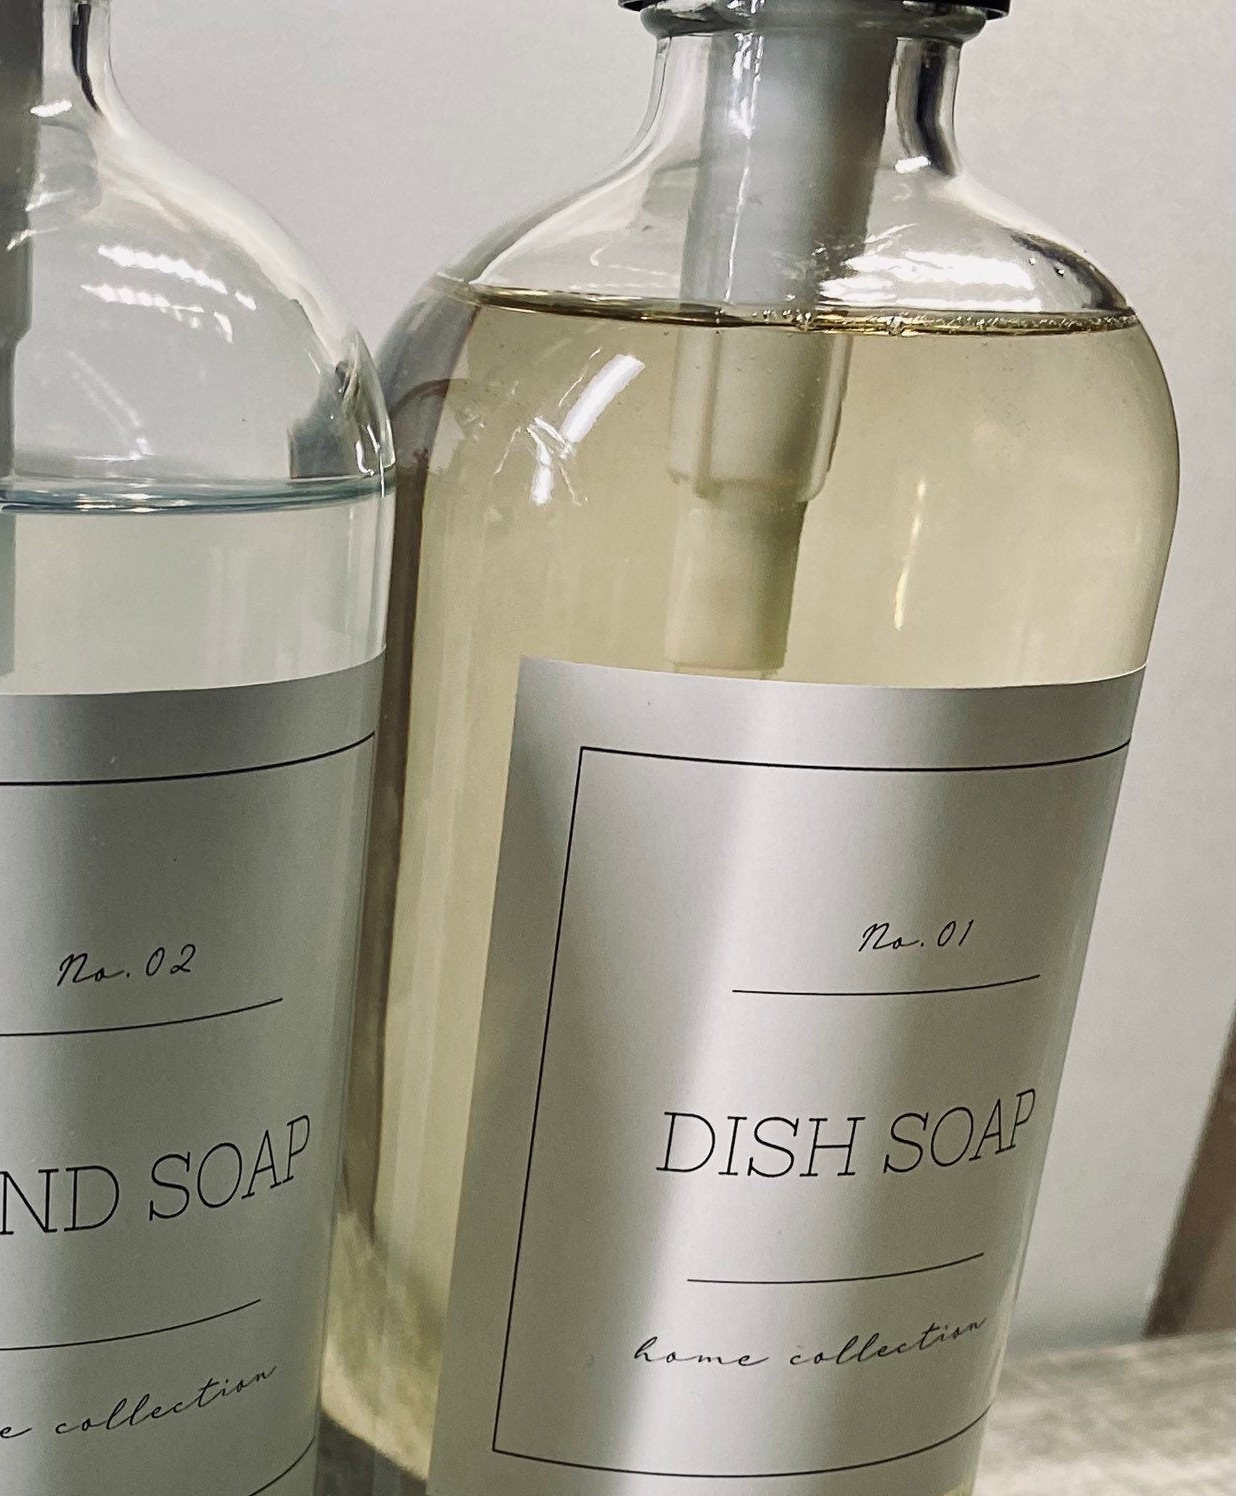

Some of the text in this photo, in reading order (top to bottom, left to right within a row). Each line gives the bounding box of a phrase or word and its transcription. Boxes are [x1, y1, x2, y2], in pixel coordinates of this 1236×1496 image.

[145, 943, 197, 977] 02
[936, 918, 975, 948] 01
[655, 1087, 1037, 1179] DISH SOAP
[148, 1114, 311, 1222] SOAP
[633, 1317, 987, 1367] home collection
[54, 1365, 277, 1435] collection
